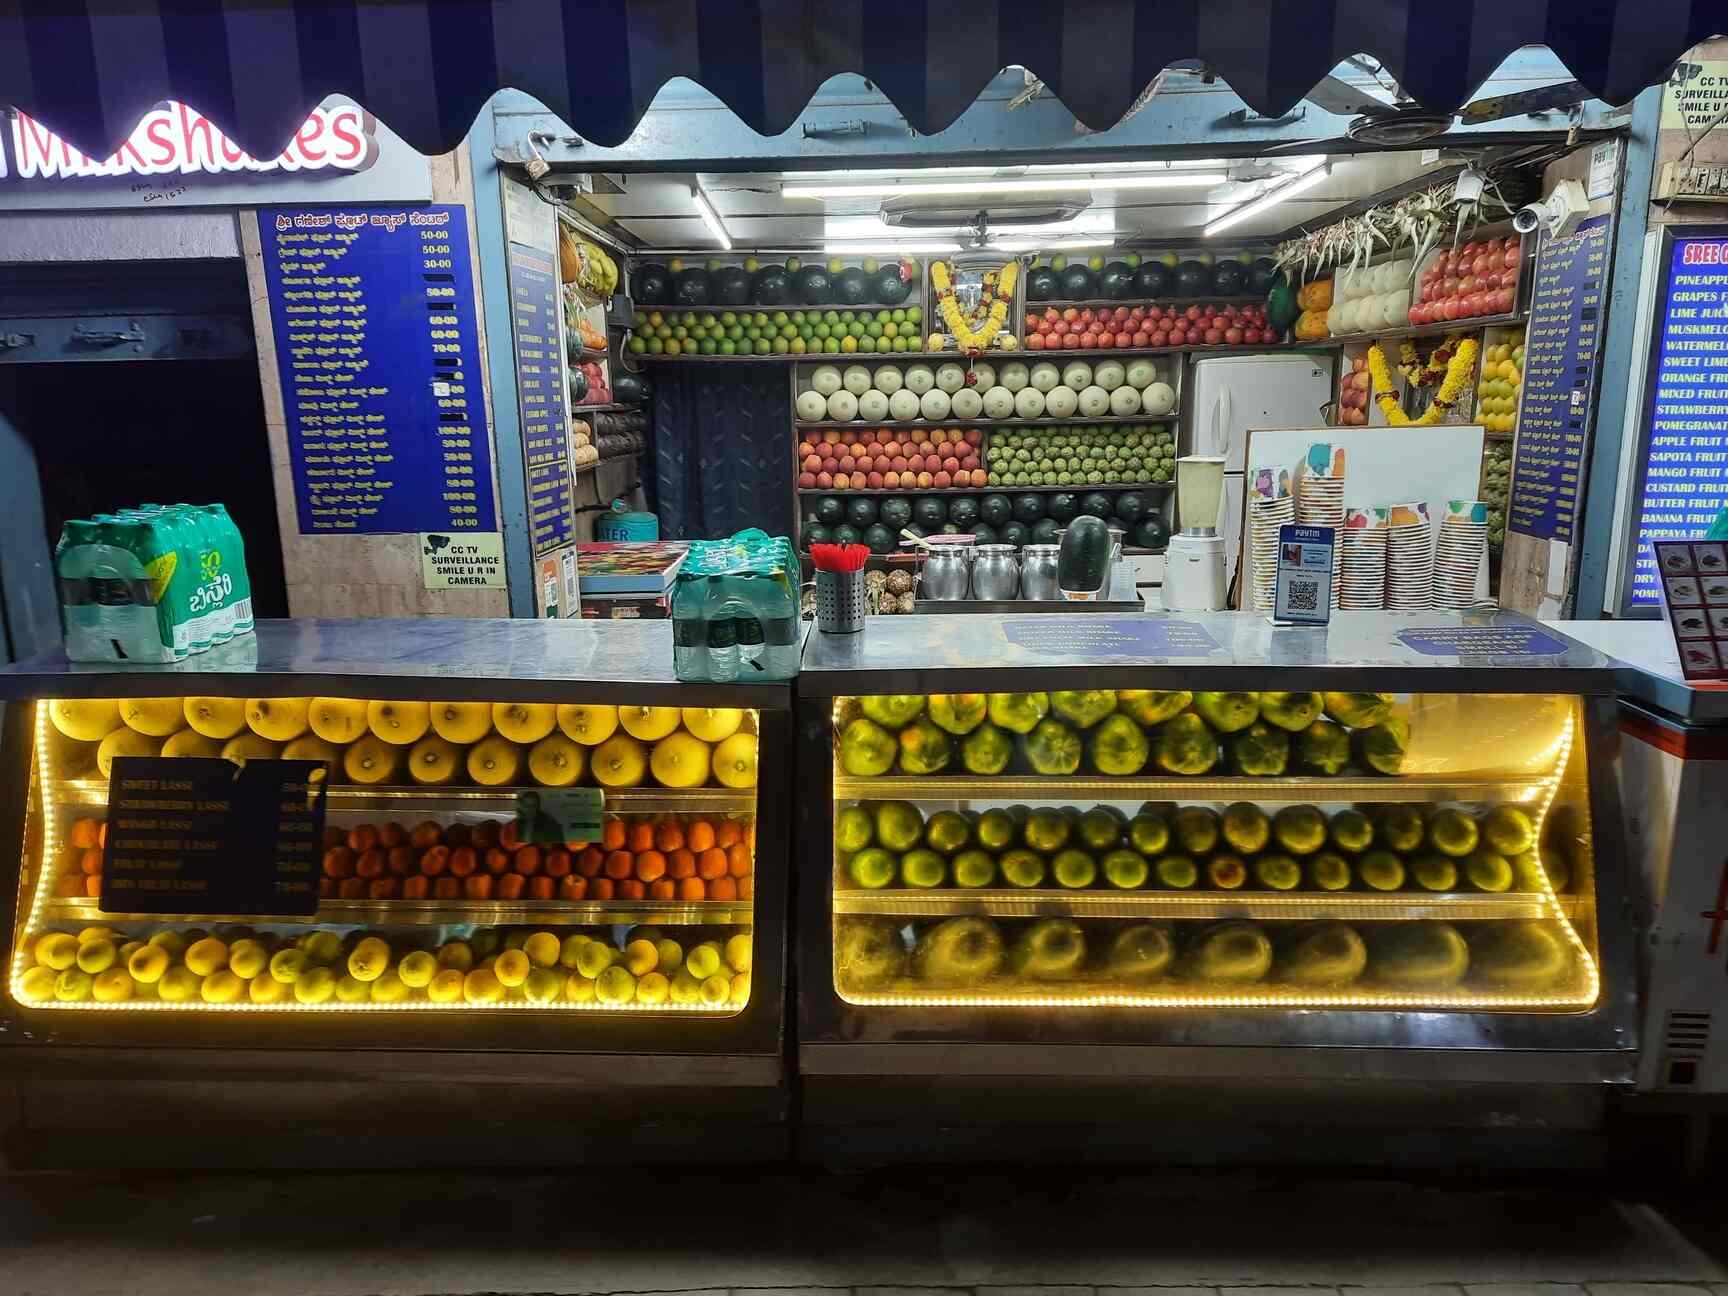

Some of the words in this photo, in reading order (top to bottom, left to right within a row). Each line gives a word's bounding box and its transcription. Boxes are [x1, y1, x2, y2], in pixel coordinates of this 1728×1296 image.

[1700, 77, 1715, 87] CC
[1683, 243, 1720, 265] SREE
[423, 259, 451, 268] 30-00
[1672, 291, 1717, 302] GRAPES
[1670, 308, 1698, 319] LIME
[1663, 356, 1700, 367] SWEET
[1661, 373, 1708, 383] ORANGE
[1658, 389, 1695, 399] MIXED
[1652, 436, 1688, 446] APPLE
[1690, 436, 1722, 446] FRUIT
[1649, 452, 1691, 462] SAPOTA
[1695, 452, 1728, 462] FRUIT
[1647, 468, 1687, 478] MANGO
[1689, 468, 1722, 478] FRUIT
[1645, 483, 1696, 493] CUSTARD
[1643, 499, 1685, 508] BUTTER
[1688, 499, 1720, 508] FRUIT
[1641, 513, 1683, 523] BANANA
[1639, 529, 1687, 539] PAPPAYA
[450, 545, 464, 554] CC
[467, 546, 478, 554] TV
[431, 556, 500, 565] SURVEILLANCE
[436, 566, 465, 575] SMILE
[467, 567, 474, 575] U
[477, 567, 483, 575] R
[486, 567, 496, 575] IN
[447, 576, 487, 585] CAMERA
